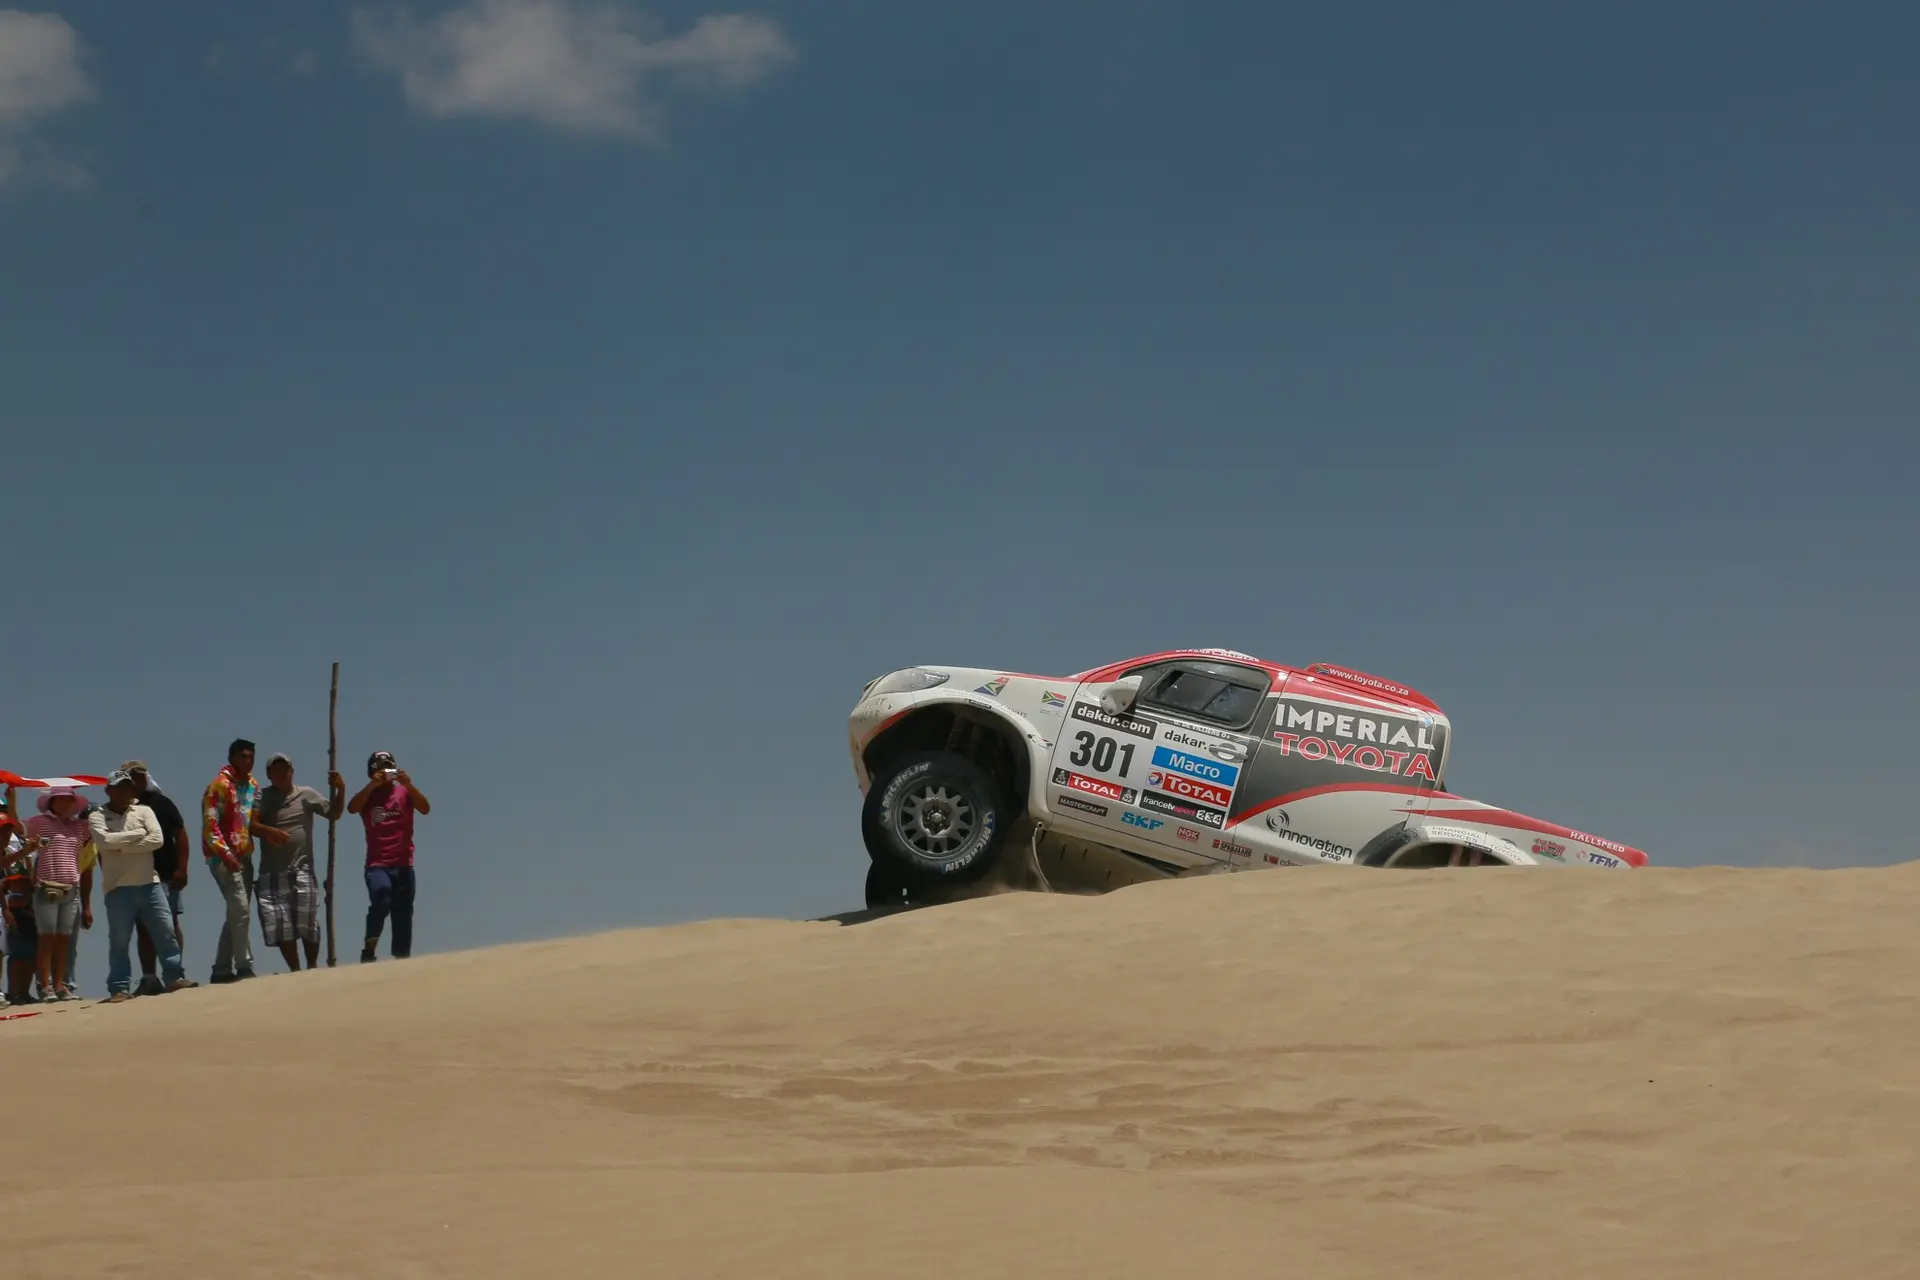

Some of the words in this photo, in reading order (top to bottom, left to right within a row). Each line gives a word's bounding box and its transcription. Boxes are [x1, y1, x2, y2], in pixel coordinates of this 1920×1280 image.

[1329, 667, 1409, 696] www.toyota.co.za
[1077, 706, 1151, 735] dakar.com
[1275, 703, 1436, 751] IMPERIAL
[1164, 730, 1216, 750] dakar.
[1070, 730, 1136, 778] 301
[1168, 753, 1220, 778] Macro
[1273, 731, 1436, 781] TOYOTA
[1072, 775, 1118, 797] TOTAL
[1167, 776, 1227, 804] TOTAL
[1060, 798, 1105, 815] MASTERCRAFT
[1120, 811, 1164, 831] SKF
[1178, 827, 1199, 840] NGK
[944, 826, 992, 872] MICHELIN
[1279, 828, 1353, 858] innovation
[1570, 831, 1625, 853] HALLSPEED
[1320, 851, 1342, 862] group
[1588, 852, 1619, 869] TFM
